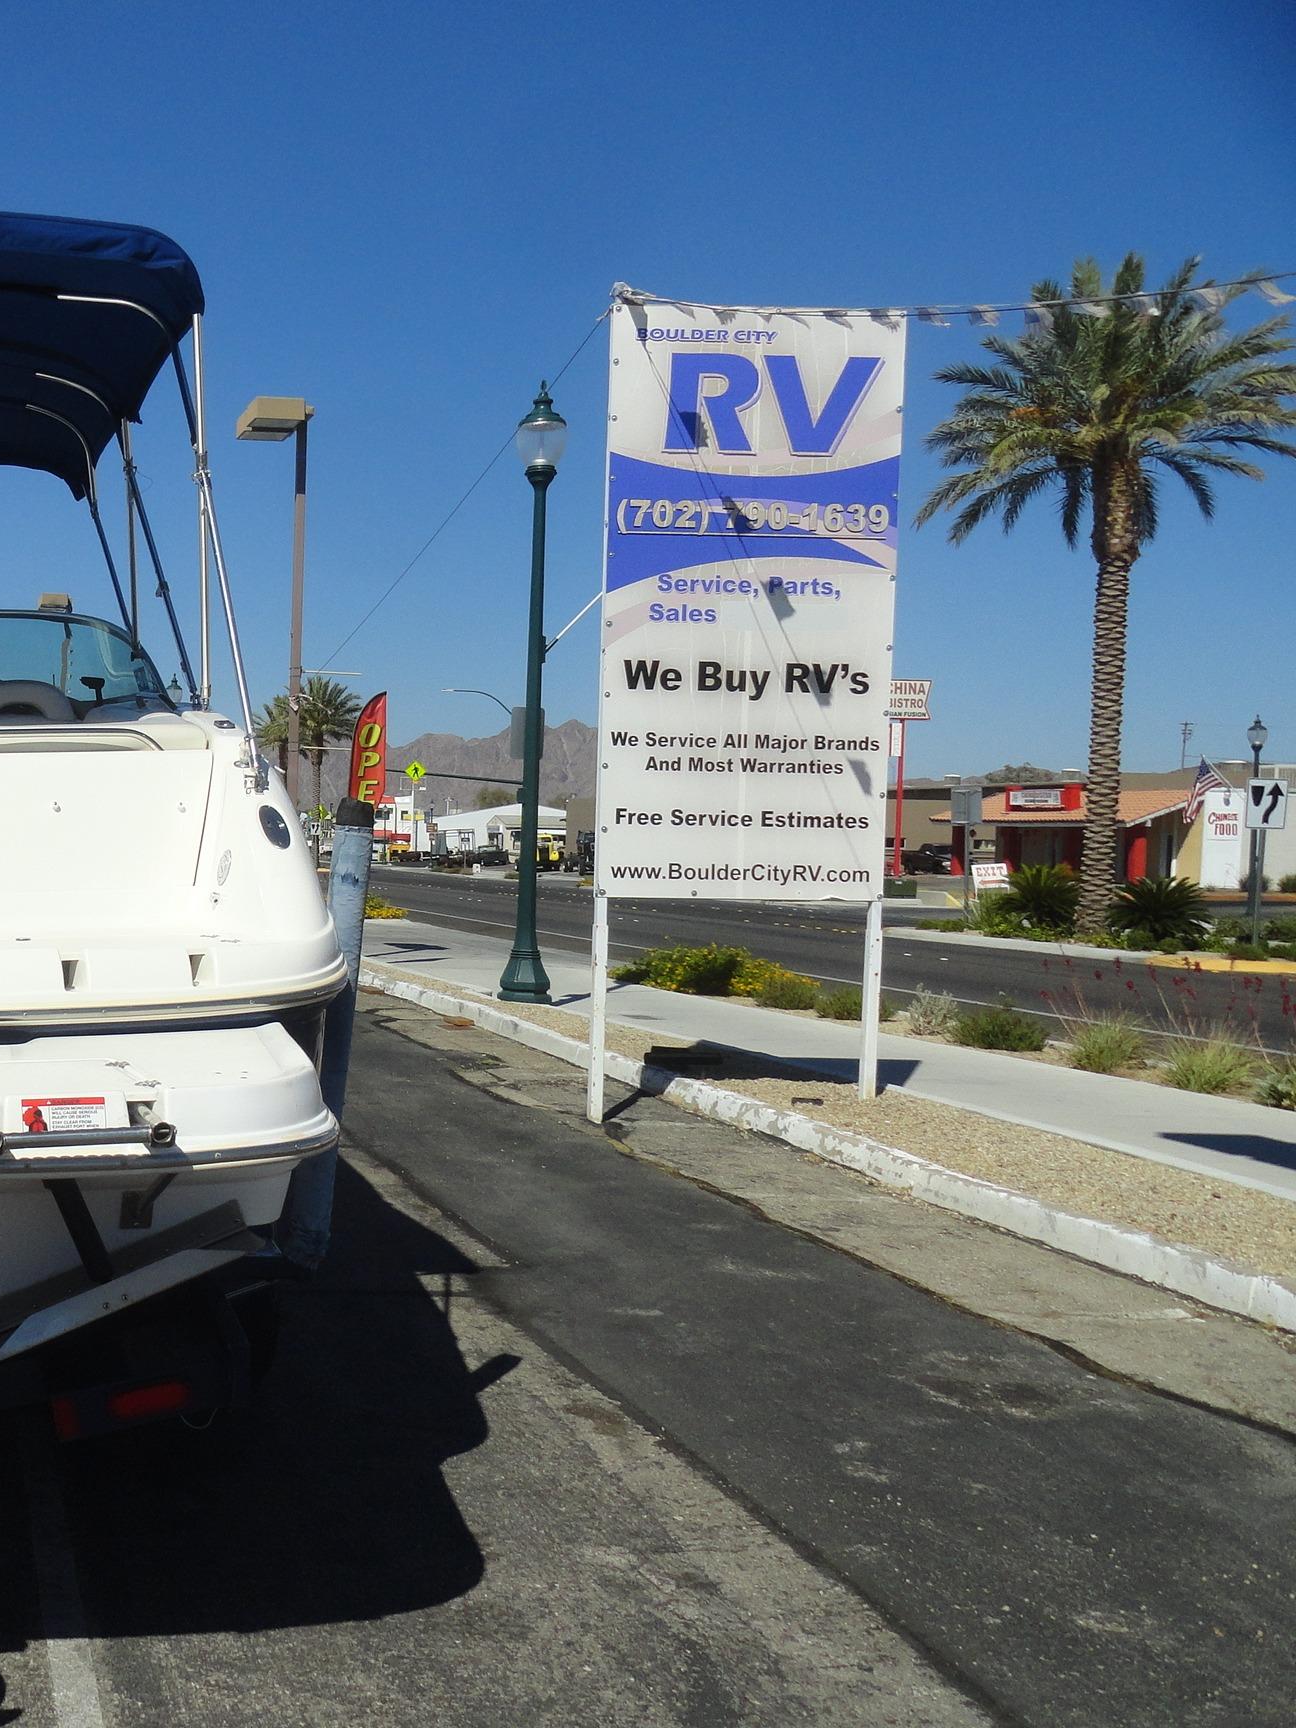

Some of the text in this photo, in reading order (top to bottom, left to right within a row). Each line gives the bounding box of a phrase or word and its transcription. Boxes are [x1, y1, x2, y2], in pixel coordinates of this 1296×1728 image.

[636, 327, 778, 345] BOULDER CITY
[661, 352, 886, 457] RV
[616, 498, 890, 535] (702) 790-1639
[657, 574, 841, 600] Service, Parts,
[648, 603, 718, 623] Sales
[624, 659, 871, 701] We Buy RV's
[610, 731, 880, 754] We Service All Major Brands
[645, 756, 844, 775] And Most Warranties
[615, 808, 870, 829] Free Service Estimates
[1214, 823, 1238, 836] FOOD
[610, 862, 871, 886] www.BoulderCityRV.com
[976, 866, 1004, 877] EXIT
